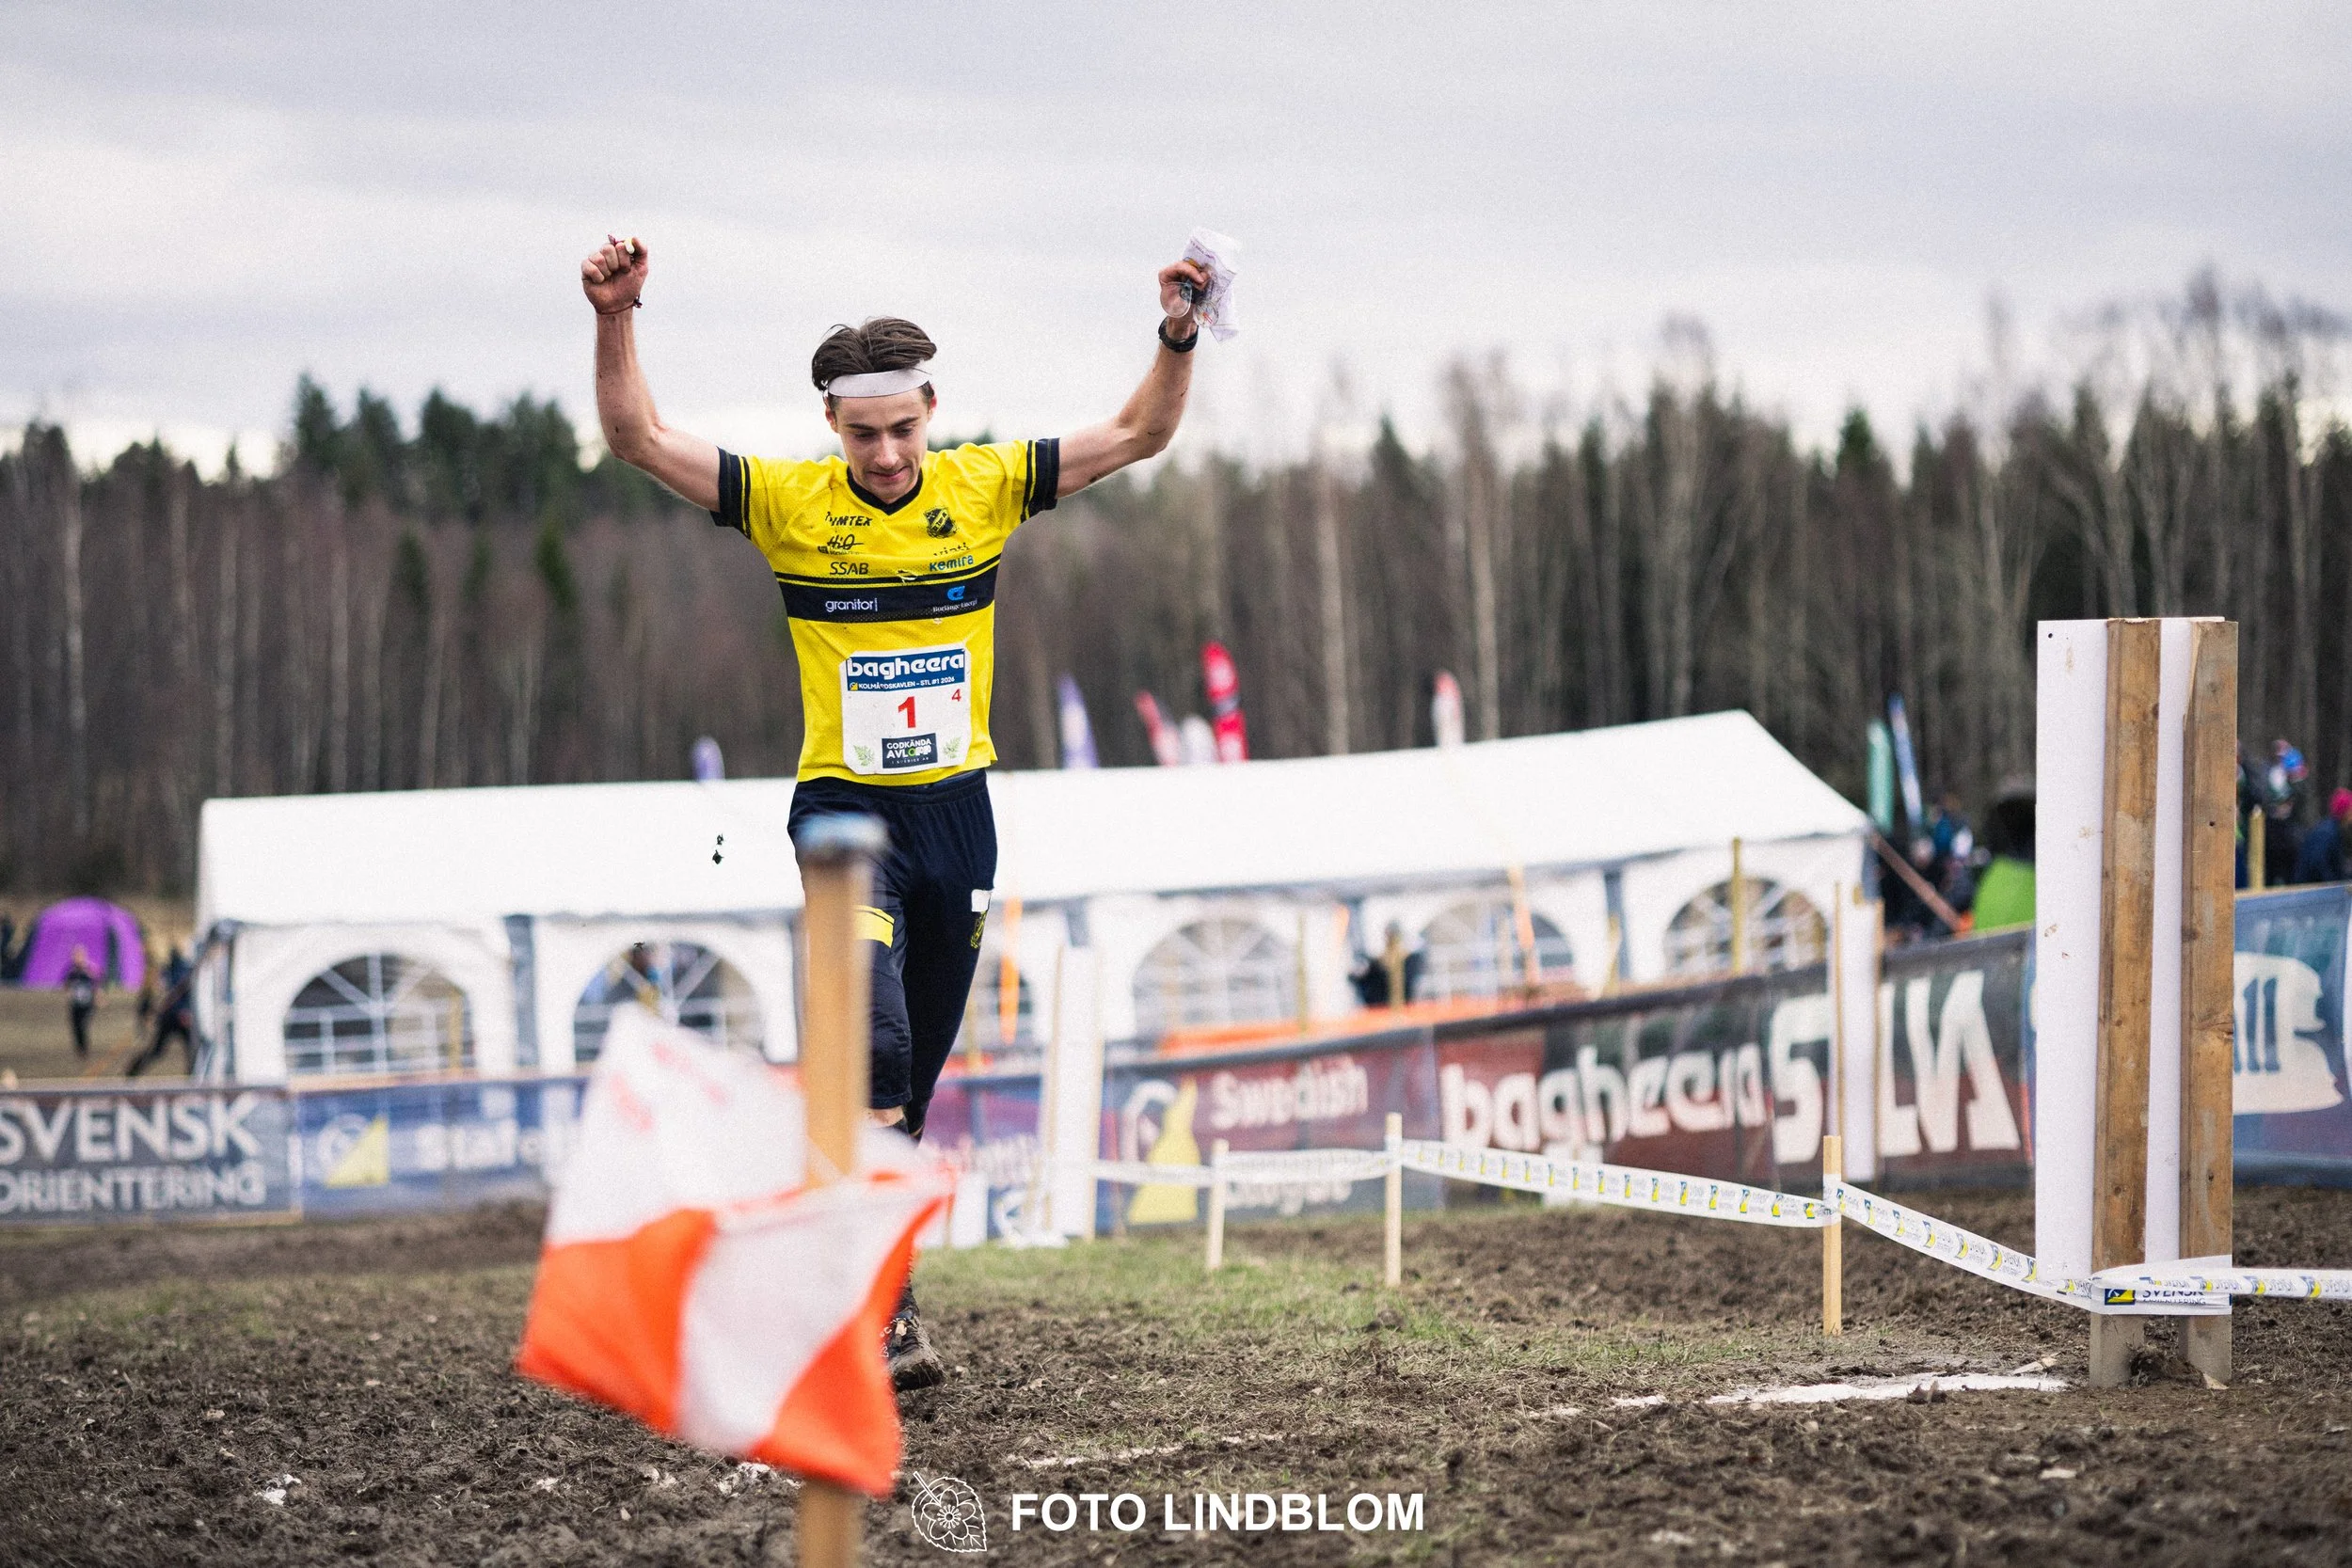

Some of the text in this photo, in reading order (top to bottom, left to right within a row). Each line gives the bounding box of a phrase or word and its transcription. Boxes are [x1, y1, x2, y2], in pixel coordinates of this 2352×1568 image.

[830, 561, 869, 576] SSAB
[825, 598, 875, 612] granitor
[848, 653, 965, 680] bagheera
[920, 678, 931, 687] STL
[951, 688, 962, 702] 4
[898, 695, 916, 729] 1
[886, 737, 932, 750] GODKÄNDA
[1770, 972, 2020, 1164] SLVA
[1439, 1044, 1767, 1155] bagheera
[0, 1090, 260, 1167] SVENSK
